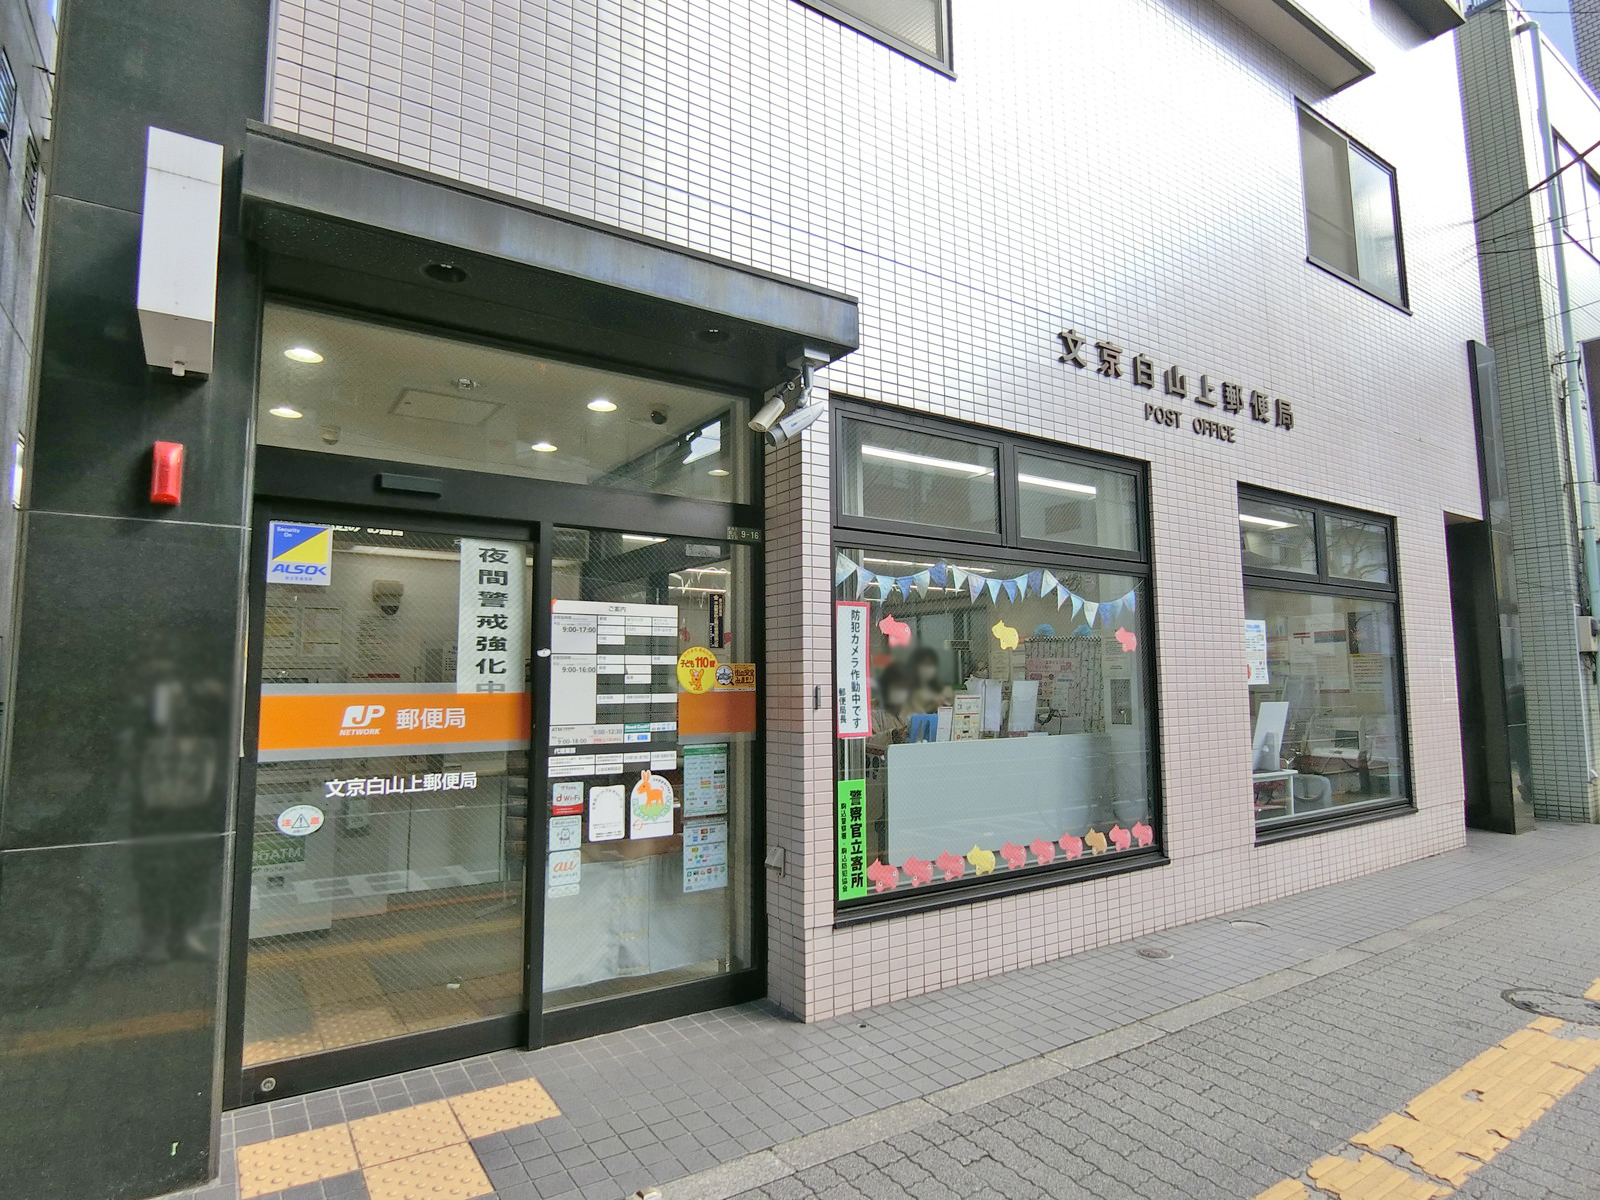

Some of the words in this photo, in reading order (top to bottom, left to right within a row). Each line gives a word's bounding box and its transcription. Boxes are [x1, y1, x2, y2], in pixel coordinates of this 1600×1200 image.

[1057, 328, 1294, 430] 文京白山上郵便局
[1145, 402, 1182, 429] POST
[1192, 416, 1236, 443] OFFICE
[277, 526, 300, 534] Security
[740, 530, 759, 540] 9-16
[272, 563, 327, 576] ALSOK
[475, 547, 509, 694] 夜間警戒強化中
[850, 609, 862, 729] 防犯カメラ作動中です
[396, 707, 466, 730] 郵便局
[838, 687, 847, 724] 郵便局長
[339, 727, 381, 736] NETWORK
[325, 772, 477, 798] 文京白山上郵便局
[849, 789, 863, 888] 警察官立寄所
